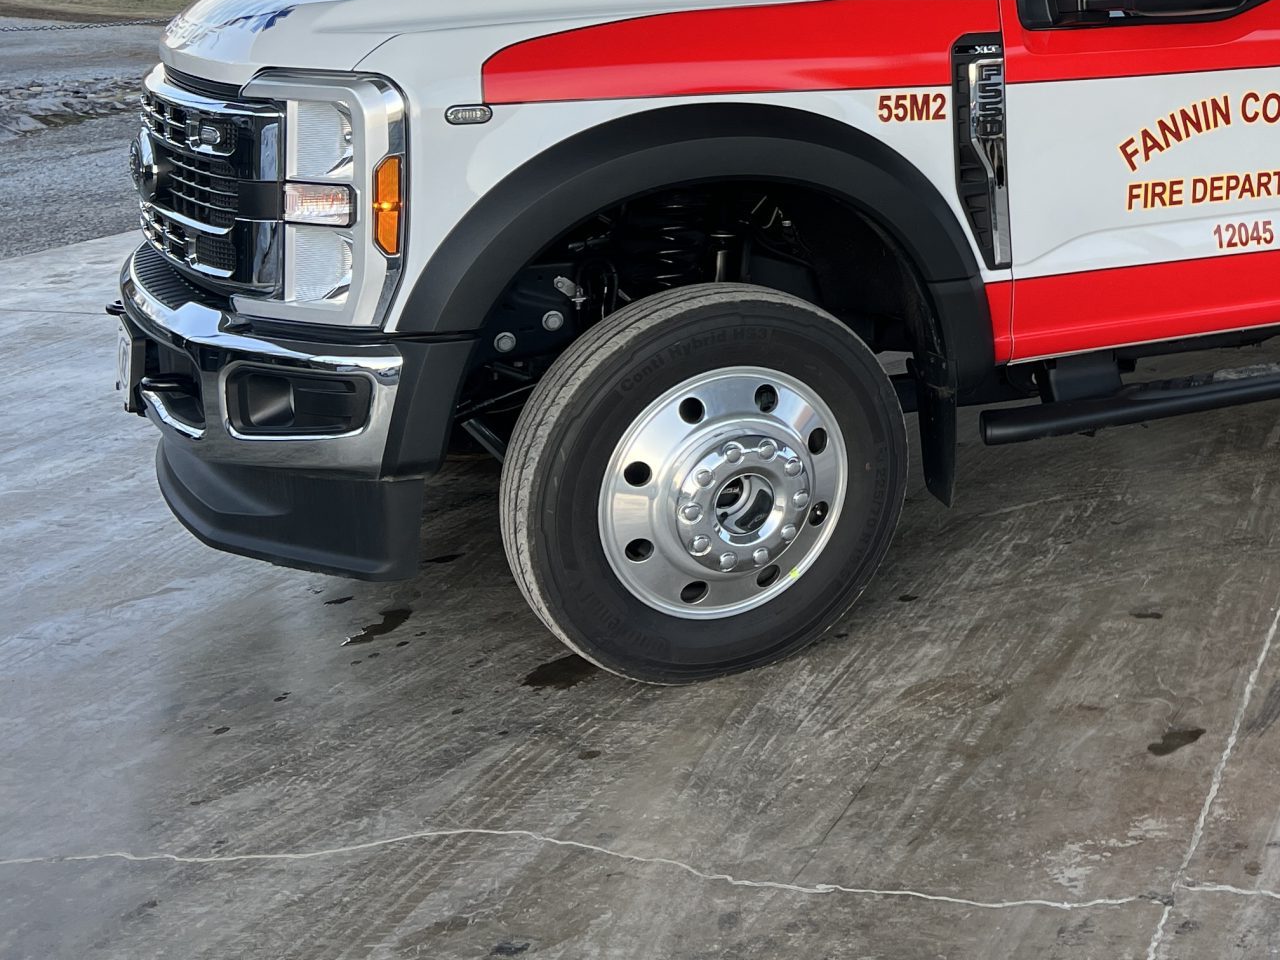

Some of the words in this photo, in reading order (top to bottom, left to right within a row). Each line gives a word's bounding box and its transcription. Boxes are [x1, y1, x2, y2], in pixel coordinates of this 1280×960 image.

[974, 45, 1000, 54] XLT
[878, 93, 947, 123] 55M2
[1119, 94, 1232, 172] FANNIN
[1127, 179, 1184, 211] FIRE
[1213, 220, 1274, 249] 12045
[620, 354, 665, 392] Conti
[668, 329, 727, 360] Hybrid
